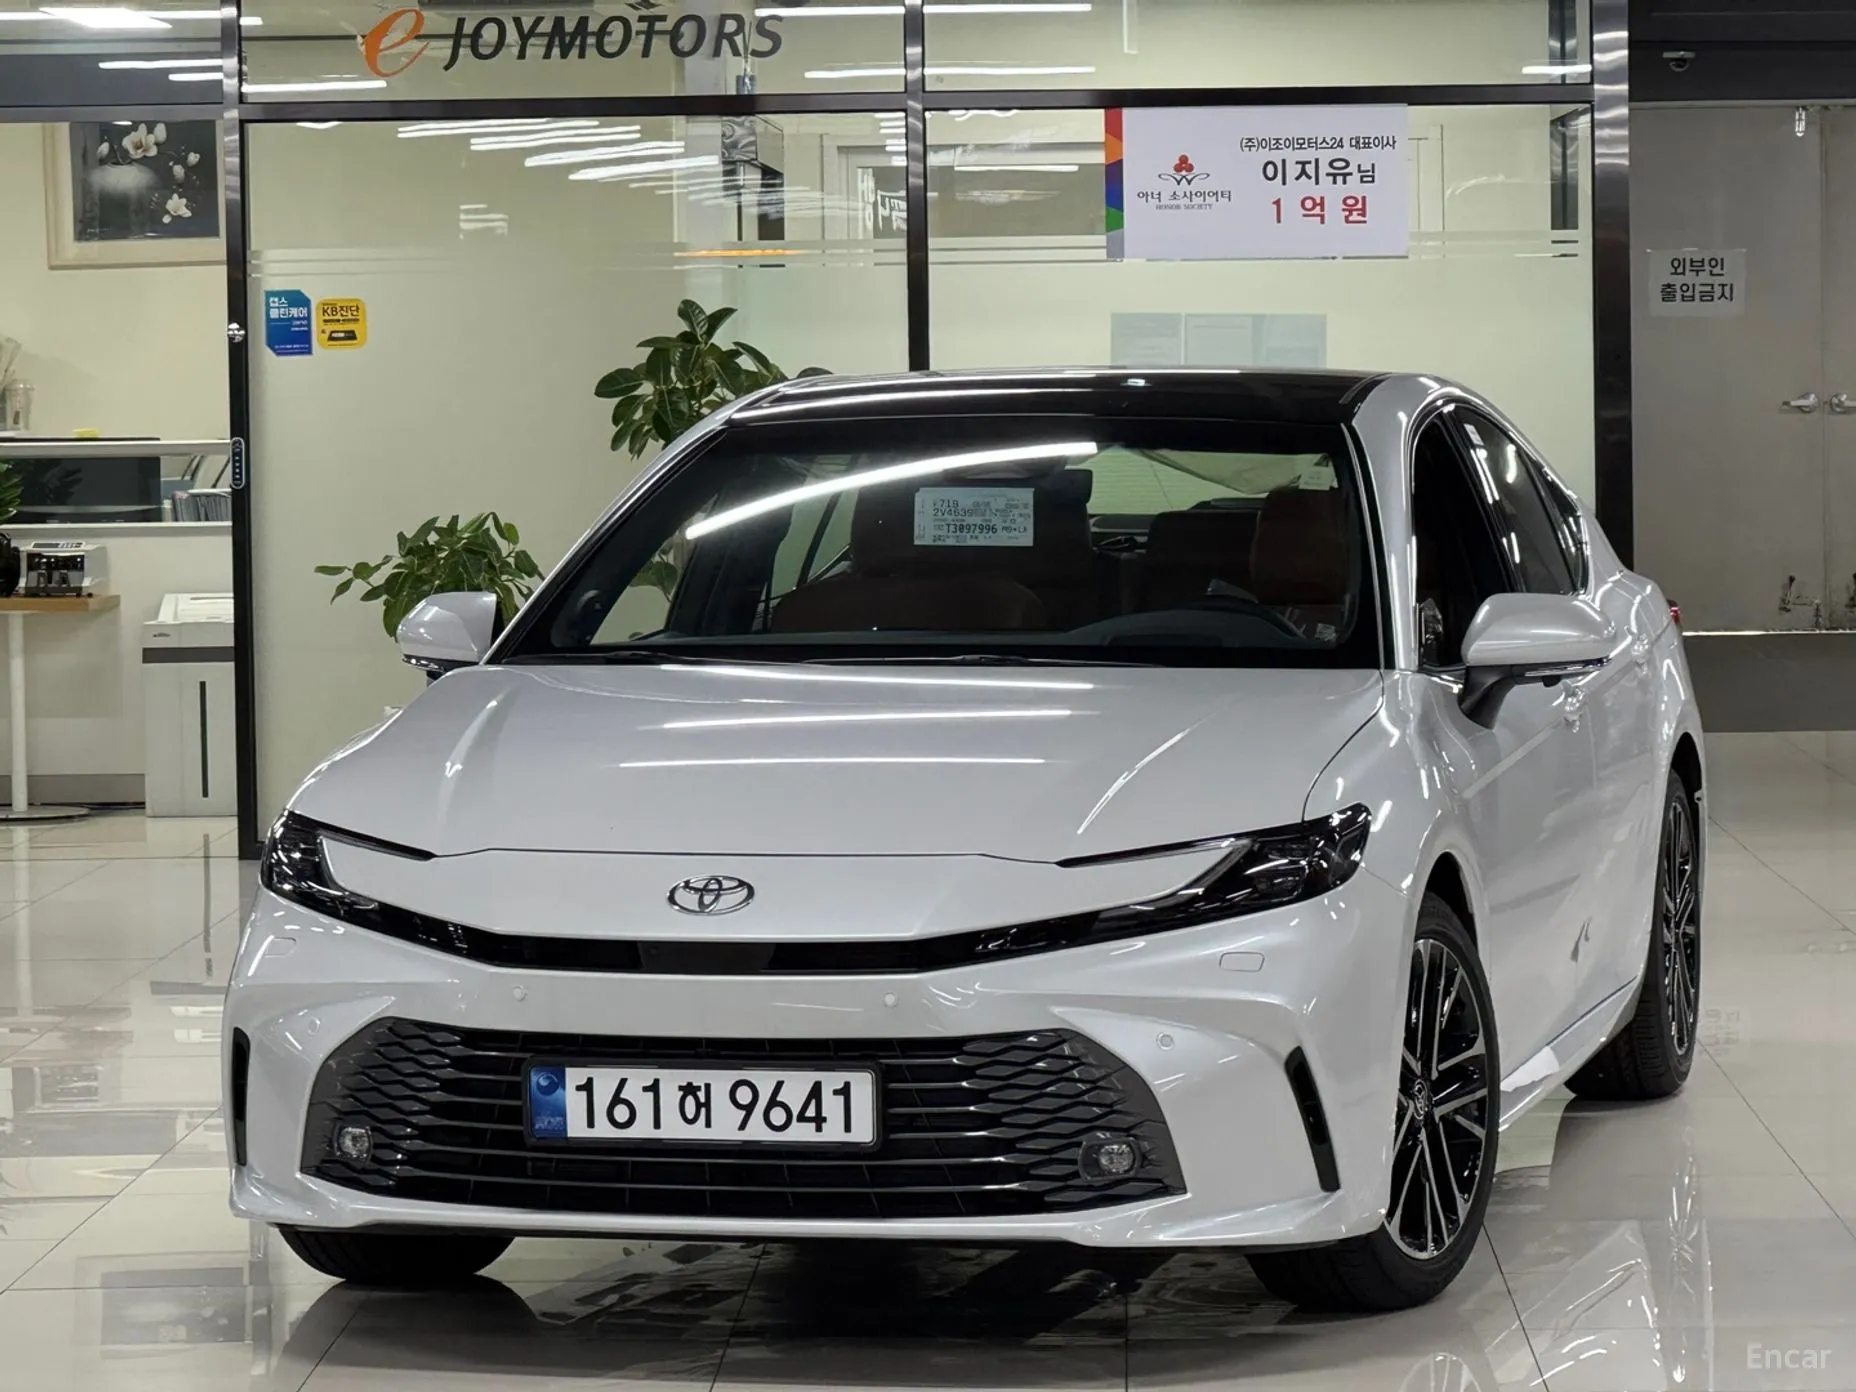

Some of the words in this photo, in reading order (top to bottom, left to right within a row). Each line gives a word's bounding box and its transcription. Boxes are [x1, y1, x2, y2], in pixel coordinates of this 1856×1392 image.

[357, 8, 430, 78] e
[442, 13, 783, 72] JOYMOTORS
[1239, 136, 1344, 152] (주)이조이모터스24
[1350, 135, 1397, 150] 대표이사
[1262, 157, 1376, 186] 이지유님
[1136, 191, 1162, 204] 아너
[1169, 190, 1232, 203] 소사이어티
[1669, 256, 1725, 277] 외부인
[1660, 282, 1734, 303] 출입금지
[322, 304, 360, 318] KB진단
[946, 523, 998, 534] T3097996
